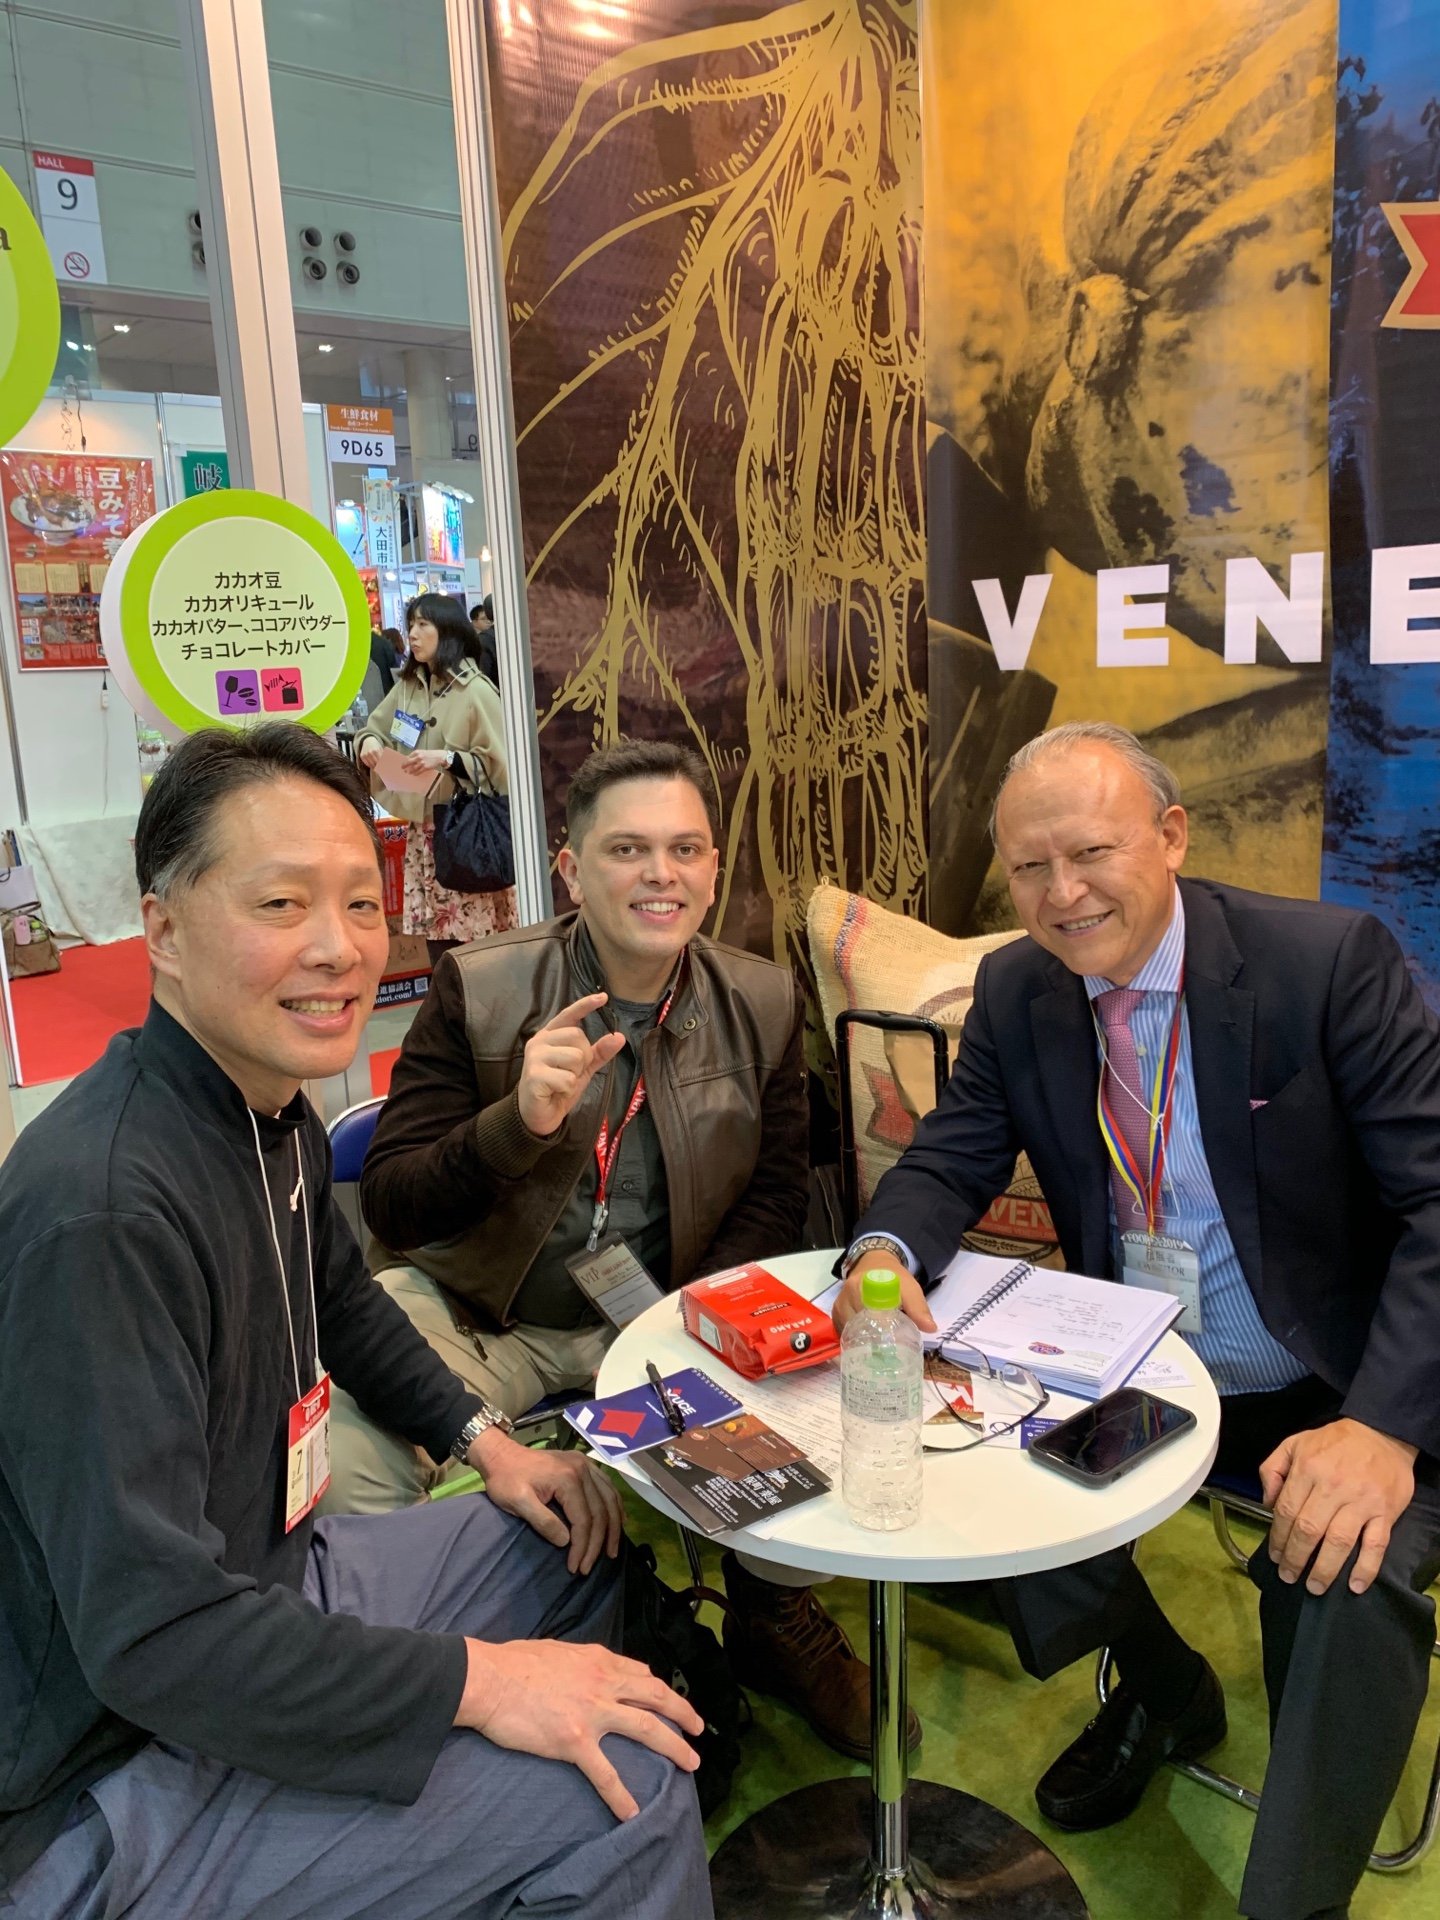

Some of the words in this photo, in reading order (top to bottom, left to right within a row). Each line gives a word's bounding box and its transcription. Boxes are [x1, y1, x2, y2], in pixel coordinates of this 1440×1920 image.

[37, 155, 65, 169] HALL
[57, 178, 78, 210] 9
[341, 439, 384, 457] 9D65
[215, 571, 282, 589] カカオ豆
[184, 593, 314, 613] カカオリキュール
[152, 614, 346, 636] カカオバター、ココアパウダー
[181, 637, 326, 660] チョコレートカバー
[667, 1388, 697, 1415] VUCE
